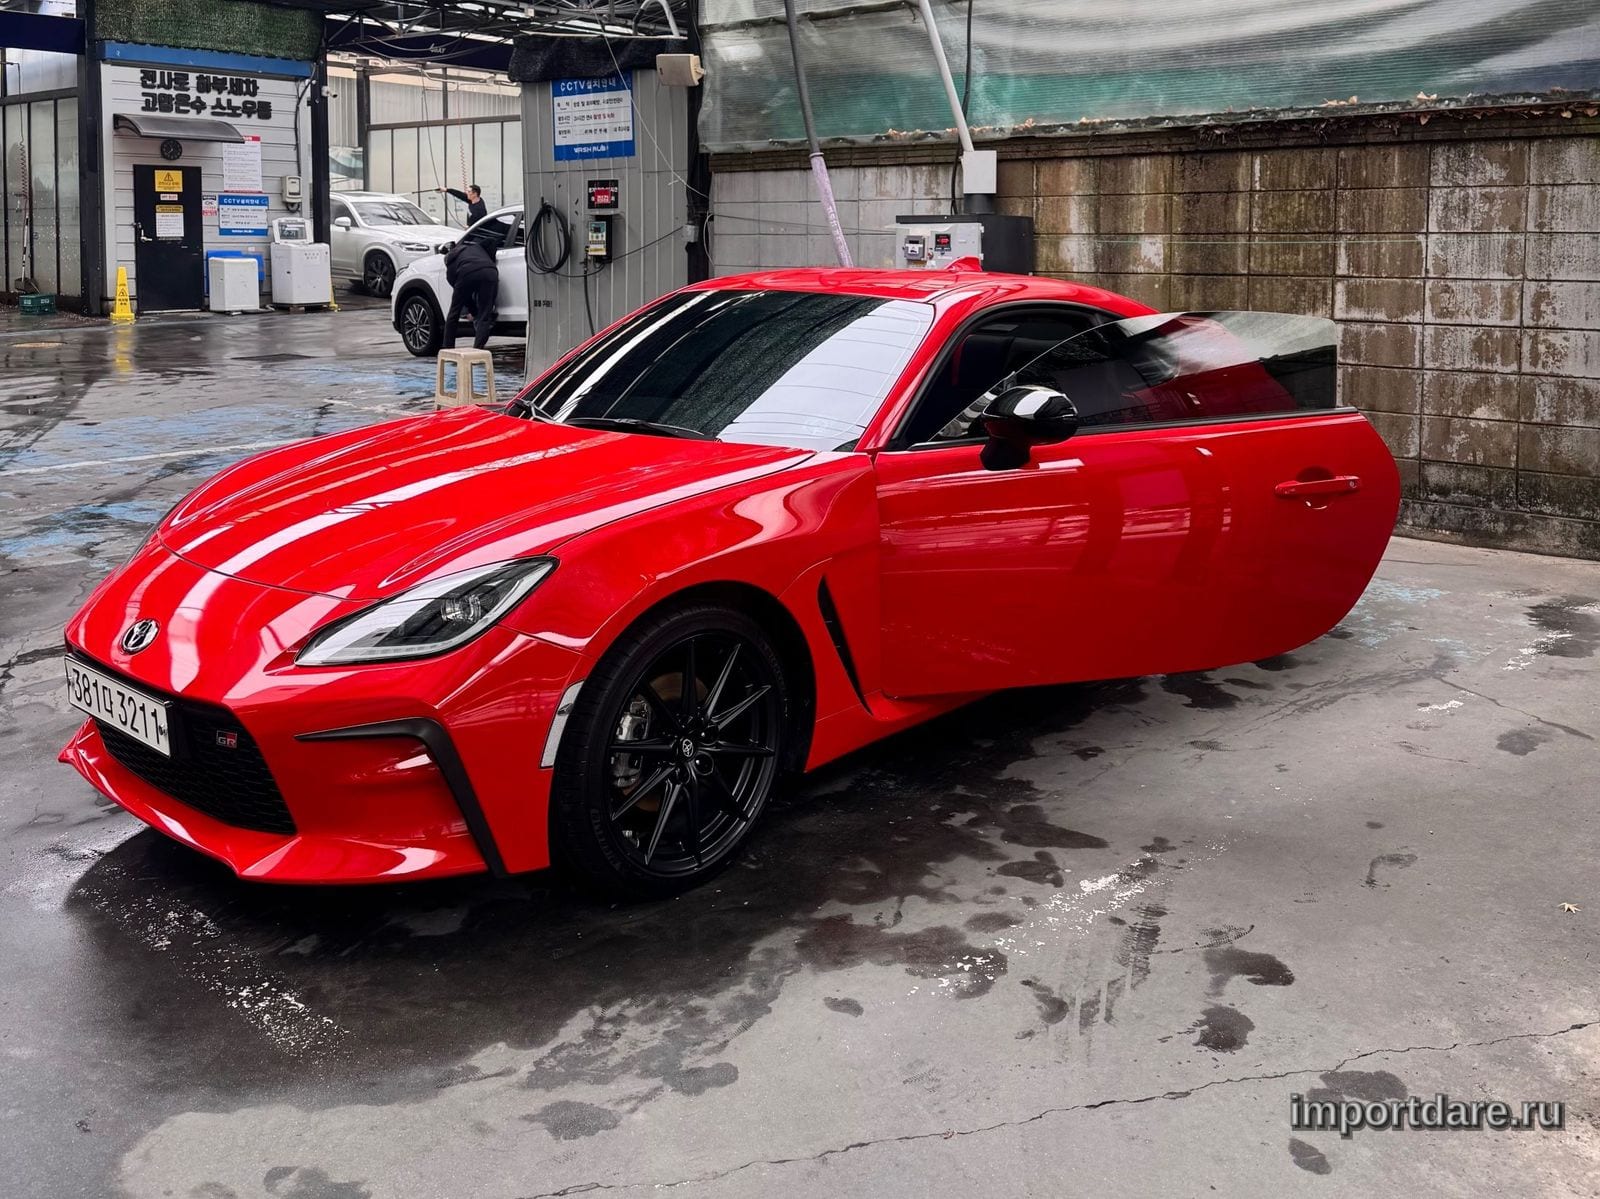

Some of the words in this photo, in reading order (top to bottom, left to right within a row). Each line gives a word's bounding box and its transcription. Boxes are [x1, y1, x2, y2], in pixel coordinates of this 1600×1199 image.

[196, 74, 259, 97] 하부세차
[141, 92, 207, 115] 고압온수
[211, 97, 272, 120] 스노우폼
[72, 667, 115, 718] 381다
[116, 689, 160, 745] 3211
[218, 736, 237, 747] GR
